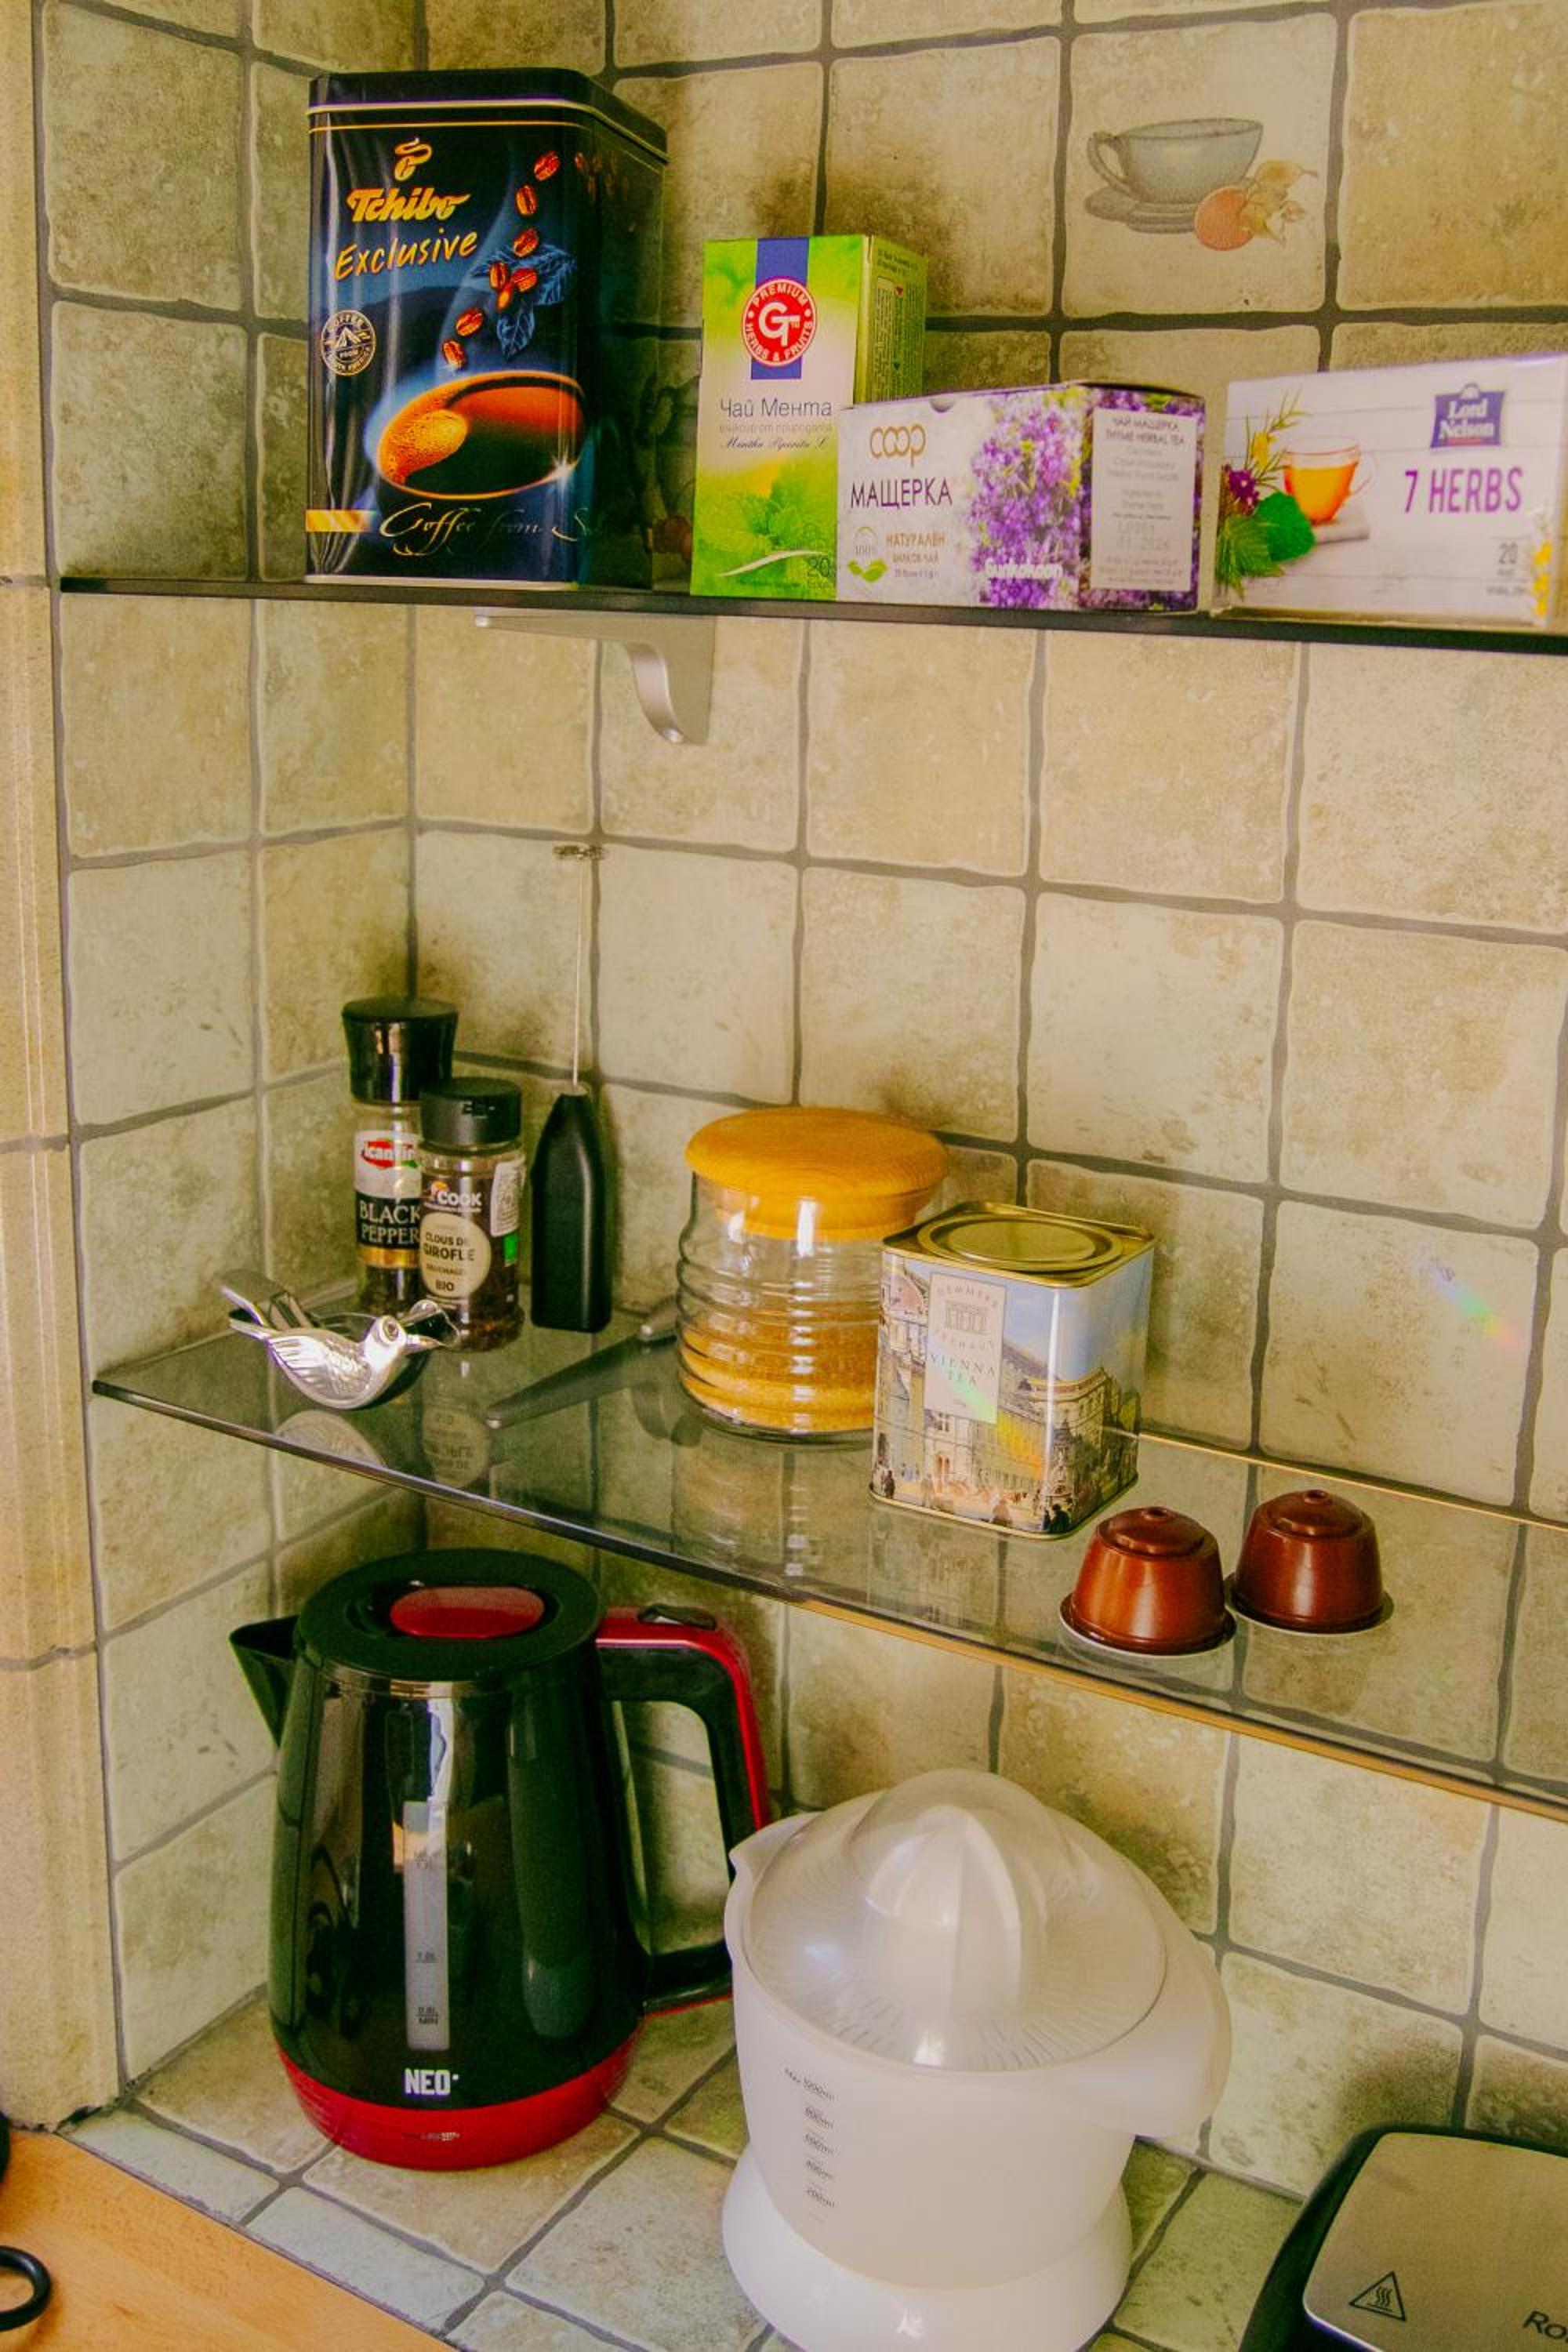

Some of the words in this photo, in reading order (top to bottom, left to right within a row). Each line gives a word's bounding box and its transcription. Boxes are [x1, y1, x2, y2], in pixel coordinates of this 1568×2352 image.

[346, 187, 470, 223] Tchibo
[334, 228, 477, 281] Exclusive
[753, 282, 808, 307] PREMIUM
[746, 322, 770, 360] HERBS
[784, 321, 813, 359] FRUITS
[720, 397, 753, 418] Чай
[760, 397, 832, 417] Мента
[1447, 398, 1487, 418] Lord
[851, 477, 953, 510] МАЩЕРКА
[1405, 470, 1418, 513] 7
[1429, 466, 1523, 513] HERBS
[379, 502, 481, 556] Coffee
[886, 532, 945, 547] НАТУРАЛЕН
[1498, 543, 1518, 564] 20
[360, 1200, 420, 1225] BLACK
[361, 1223, 419, 1244] PEPPER
[425, 1232, 453, 1245] CLOUS
[436, 1279, 455, 1291] BIO
[931, 1354, 996, 1376] VIENNA
[947, 1370, 977, 1386] TEA
[1522, 2310, 1568, 2343] Ro
